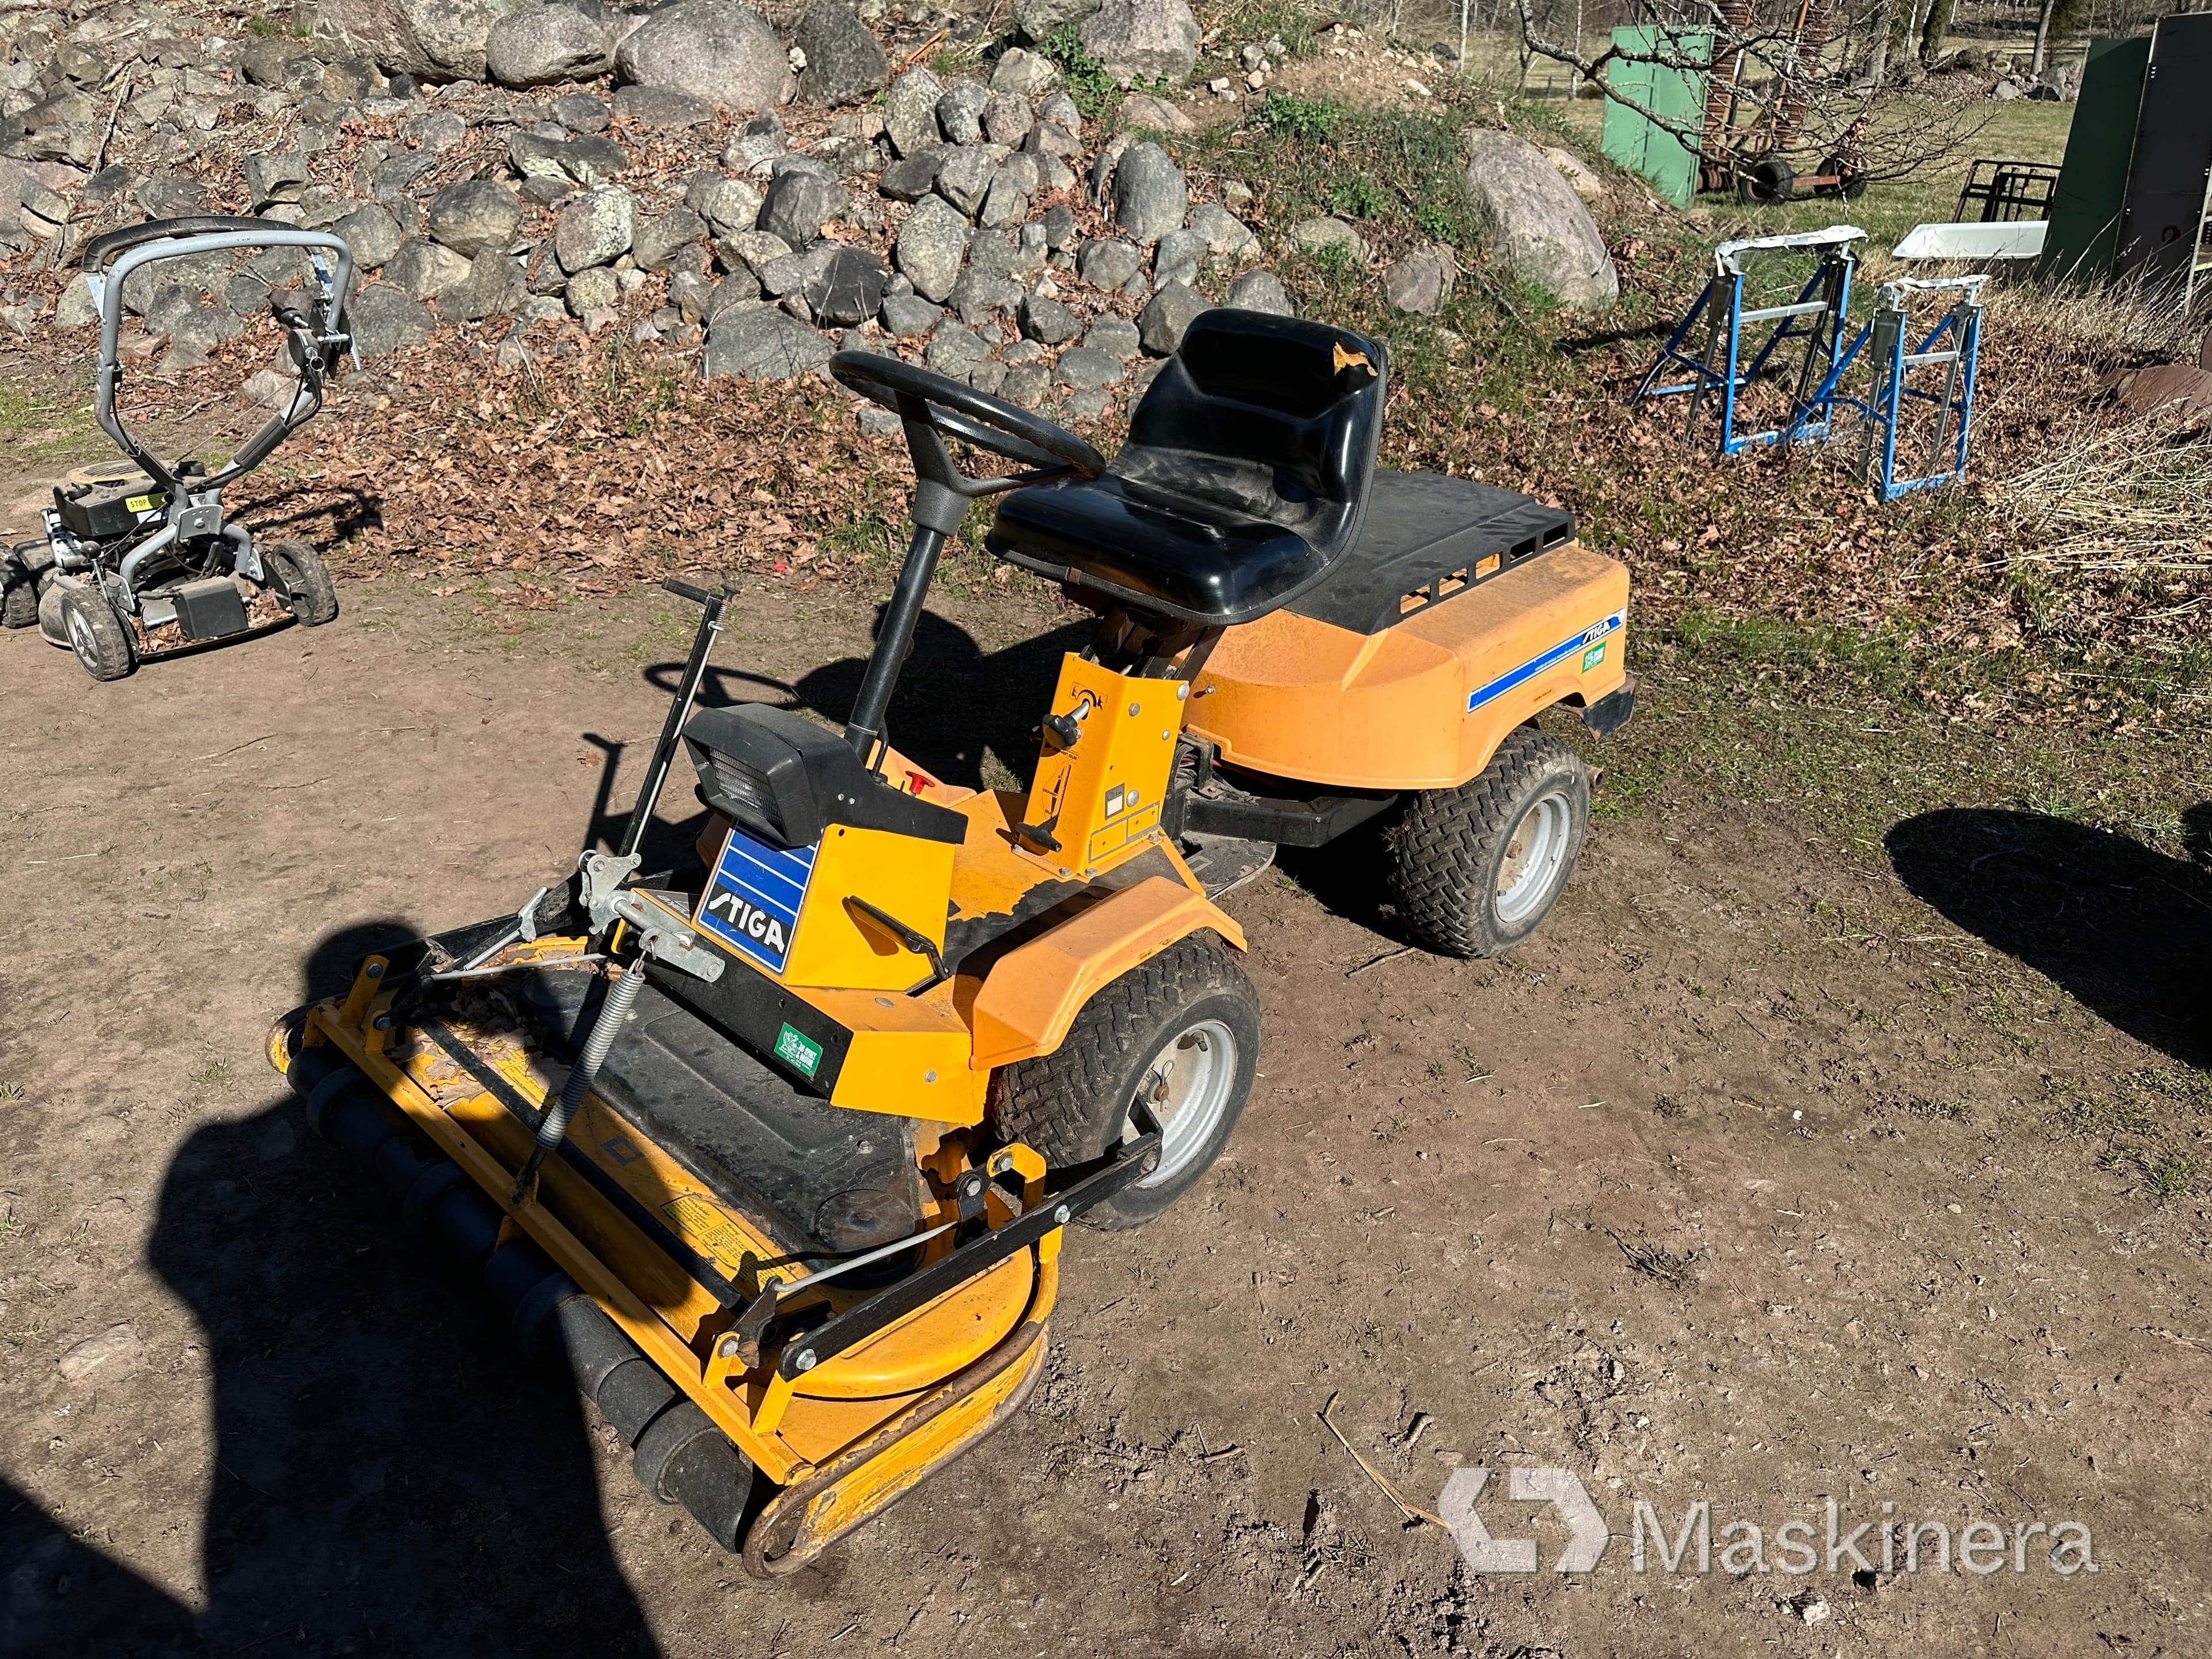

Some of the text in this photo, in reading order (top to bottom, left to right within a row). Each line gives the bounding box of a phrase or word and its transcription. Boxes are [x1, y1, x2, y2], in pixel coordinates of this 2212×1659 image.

[130, 499, 147, 508] STOP
[1582, 620, 1611, 645] STIGA
[708, 892, 785, 953] STIGA
